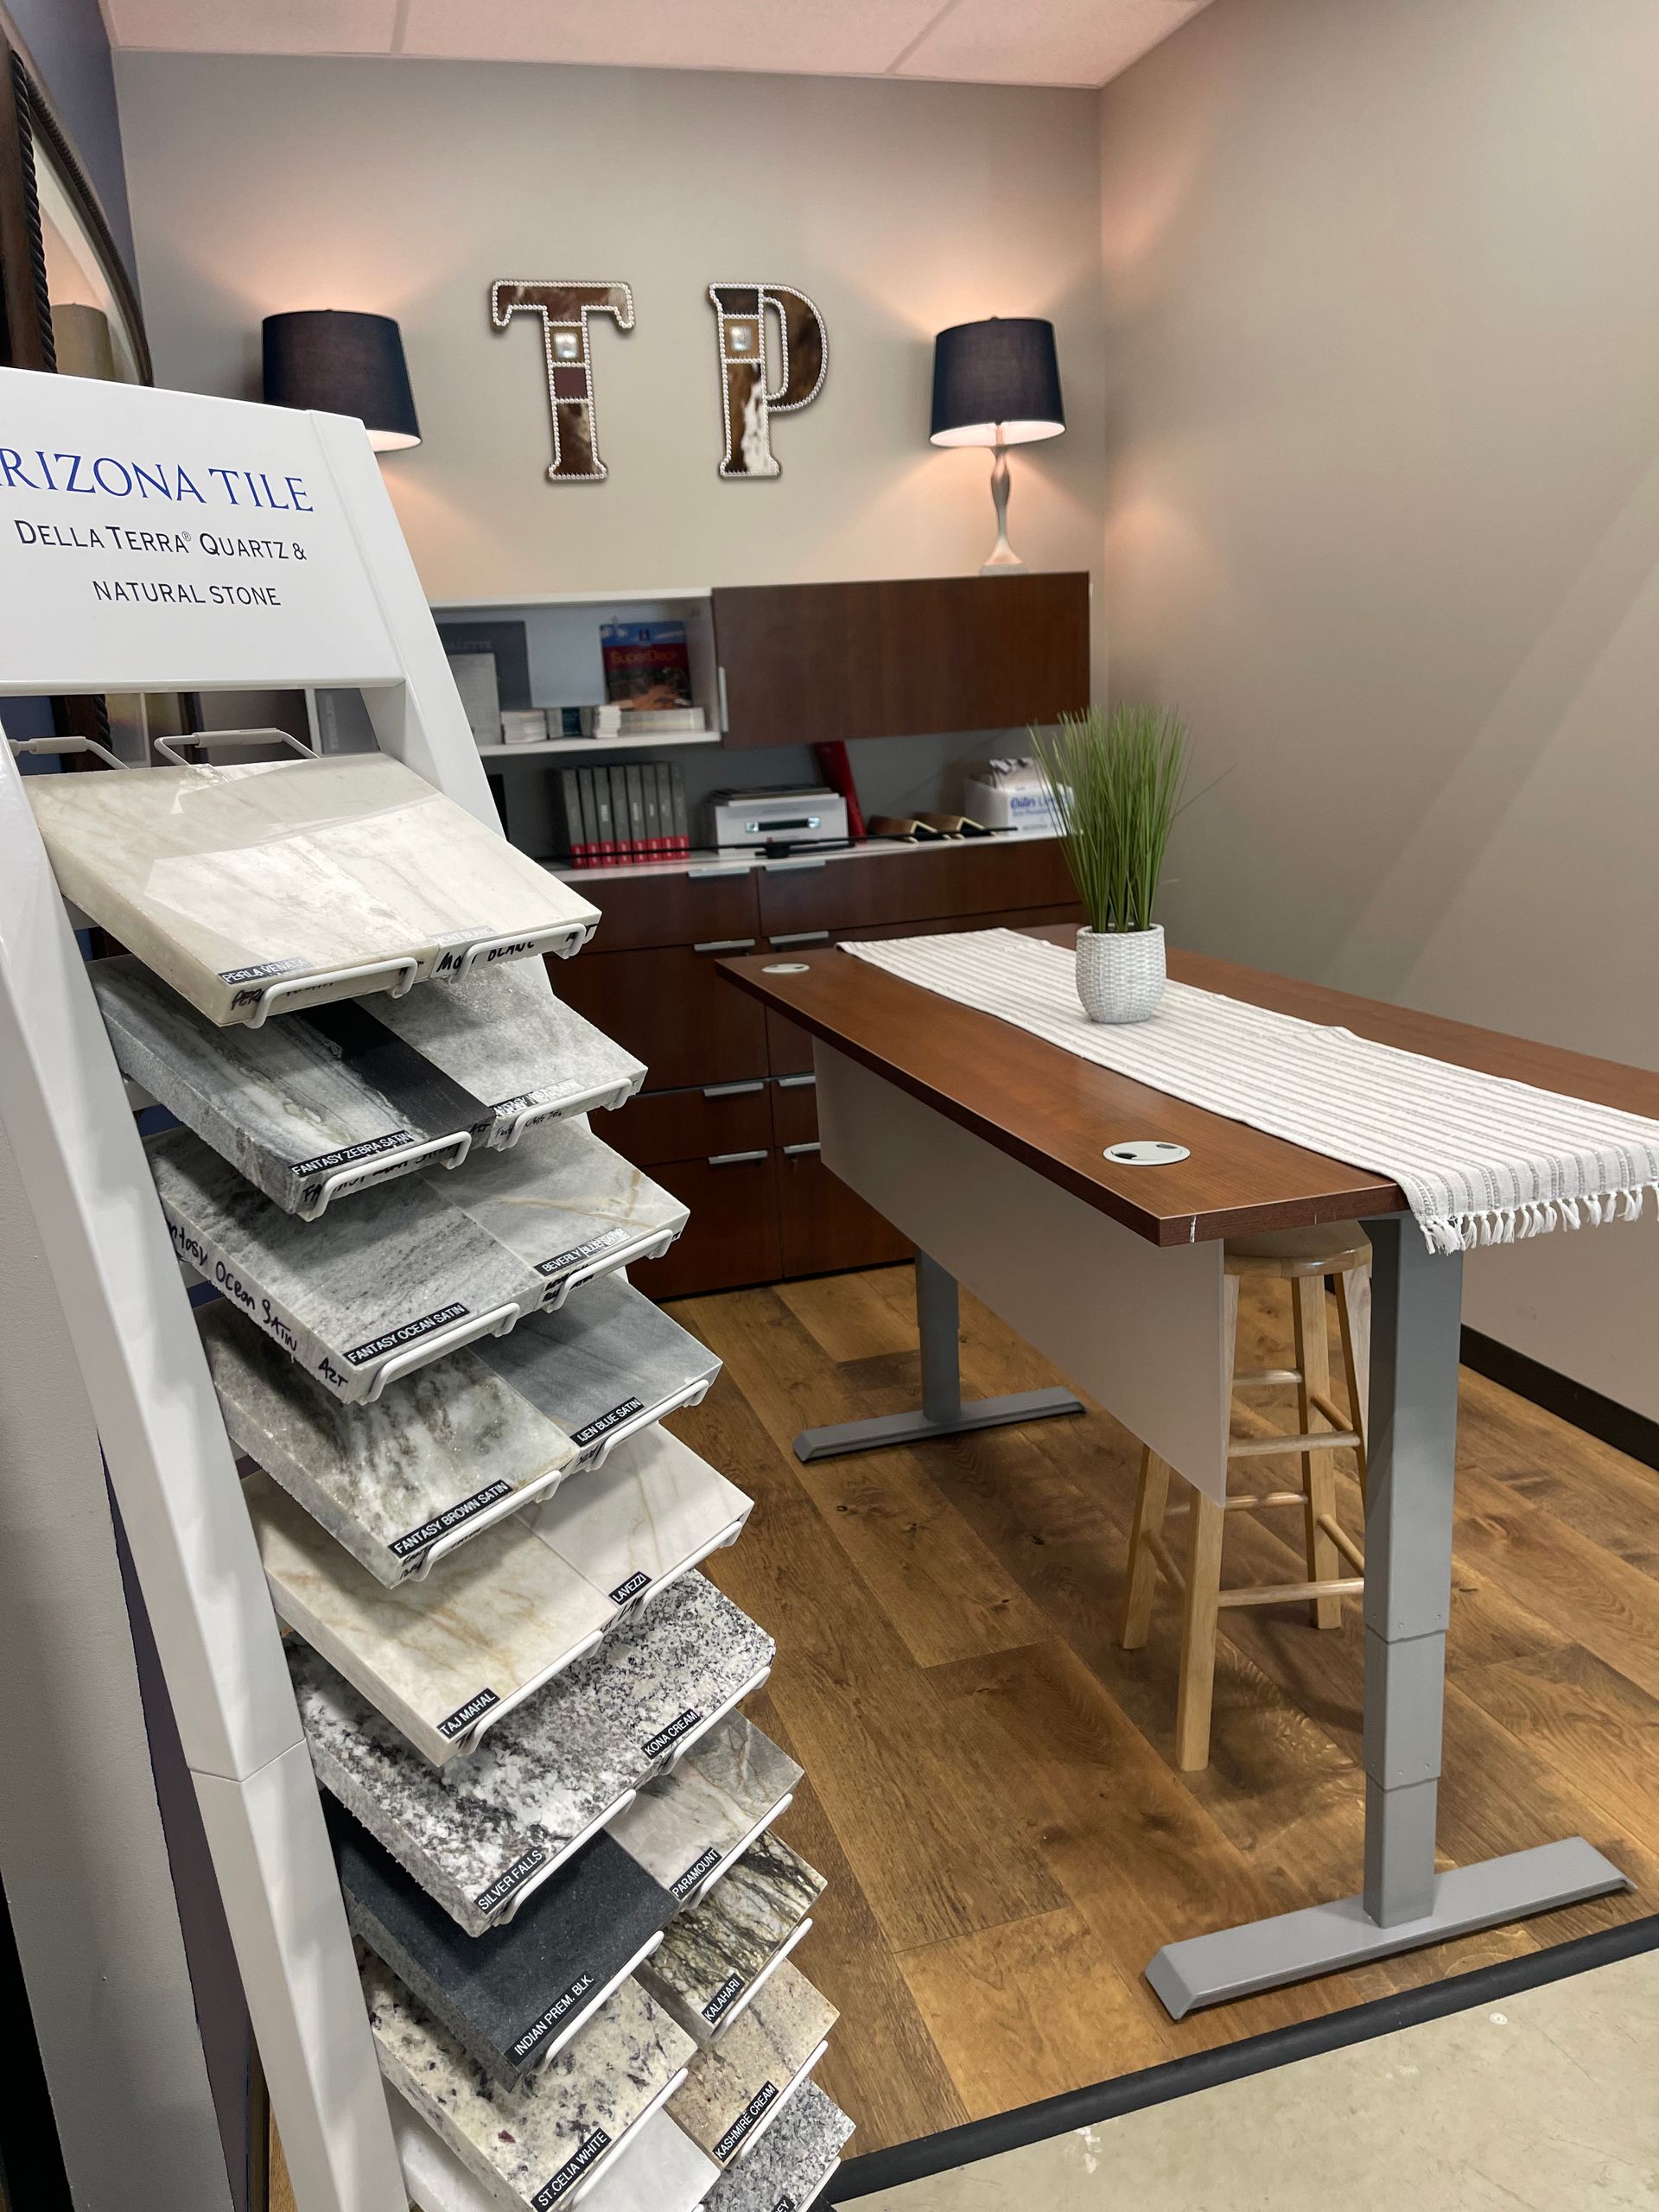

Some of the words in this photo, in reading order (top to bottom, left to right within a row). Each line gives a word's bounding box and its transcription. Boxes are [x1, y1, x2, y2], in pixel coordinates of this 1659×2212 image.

[492, 280, 635, 480] T
[709, 283, 829, 478] P
[0, 448, 207, 504] RIZONA
[207, 467, 314, 512] TILE
[292, 543, 307, 560] &
[92, 580, 206, 603] NATURAL
[209, 585, 282, 606] STONE
[221, 967, 264, 983] PERLA
[291, 1153, 344, 1175] FANTASY
[343, 1141, 382, 1159] ZEBRA
[379, 1131, 415, 1147] SATIN
[541, 1249, 582, 1272] BEVERLY
[347, 1333, 398, 1363] FANTASY
[397, 1318, 436, 1340] OCEAN
[433, 1305, 466, 1323] SATIN
[594, 1413, 620, 1431] BLUE
[615, 1399, 641, 1417] SATIN
[393, 1520, 443, 1554] FANTASY
[441, 1498, 481, 1526] BROWN
[477, 1482, 509, 1503] SATIN
[612, 1573, 647, 1603] LAVEZZI
[439, 1716, 462, 1735] TAJ
[458, 1693, 496, 1722] MAHAL
[644, 1733, 671, 1756] KONA
[667, 1711, 698, 1737] CREAM
[478, 1875, 516, 1910] SILVER
[511, 1850, 543, 1880] FALLS
[671, 1848, 718, 1897] PARAMOUNT
[513, 2020, 548, 2056] INDIAN
[543, 1993, 575, 2025] PREM.
[571, 1974, 594, 1996] BLK.
[704, 1978, 741, 2021] KALAHARI
[715, 2113, 753, 2159] KASHMIRE
[749, 2083, 776, 2115] CREAM
[575, 2132, 607, 2164] WHITE
